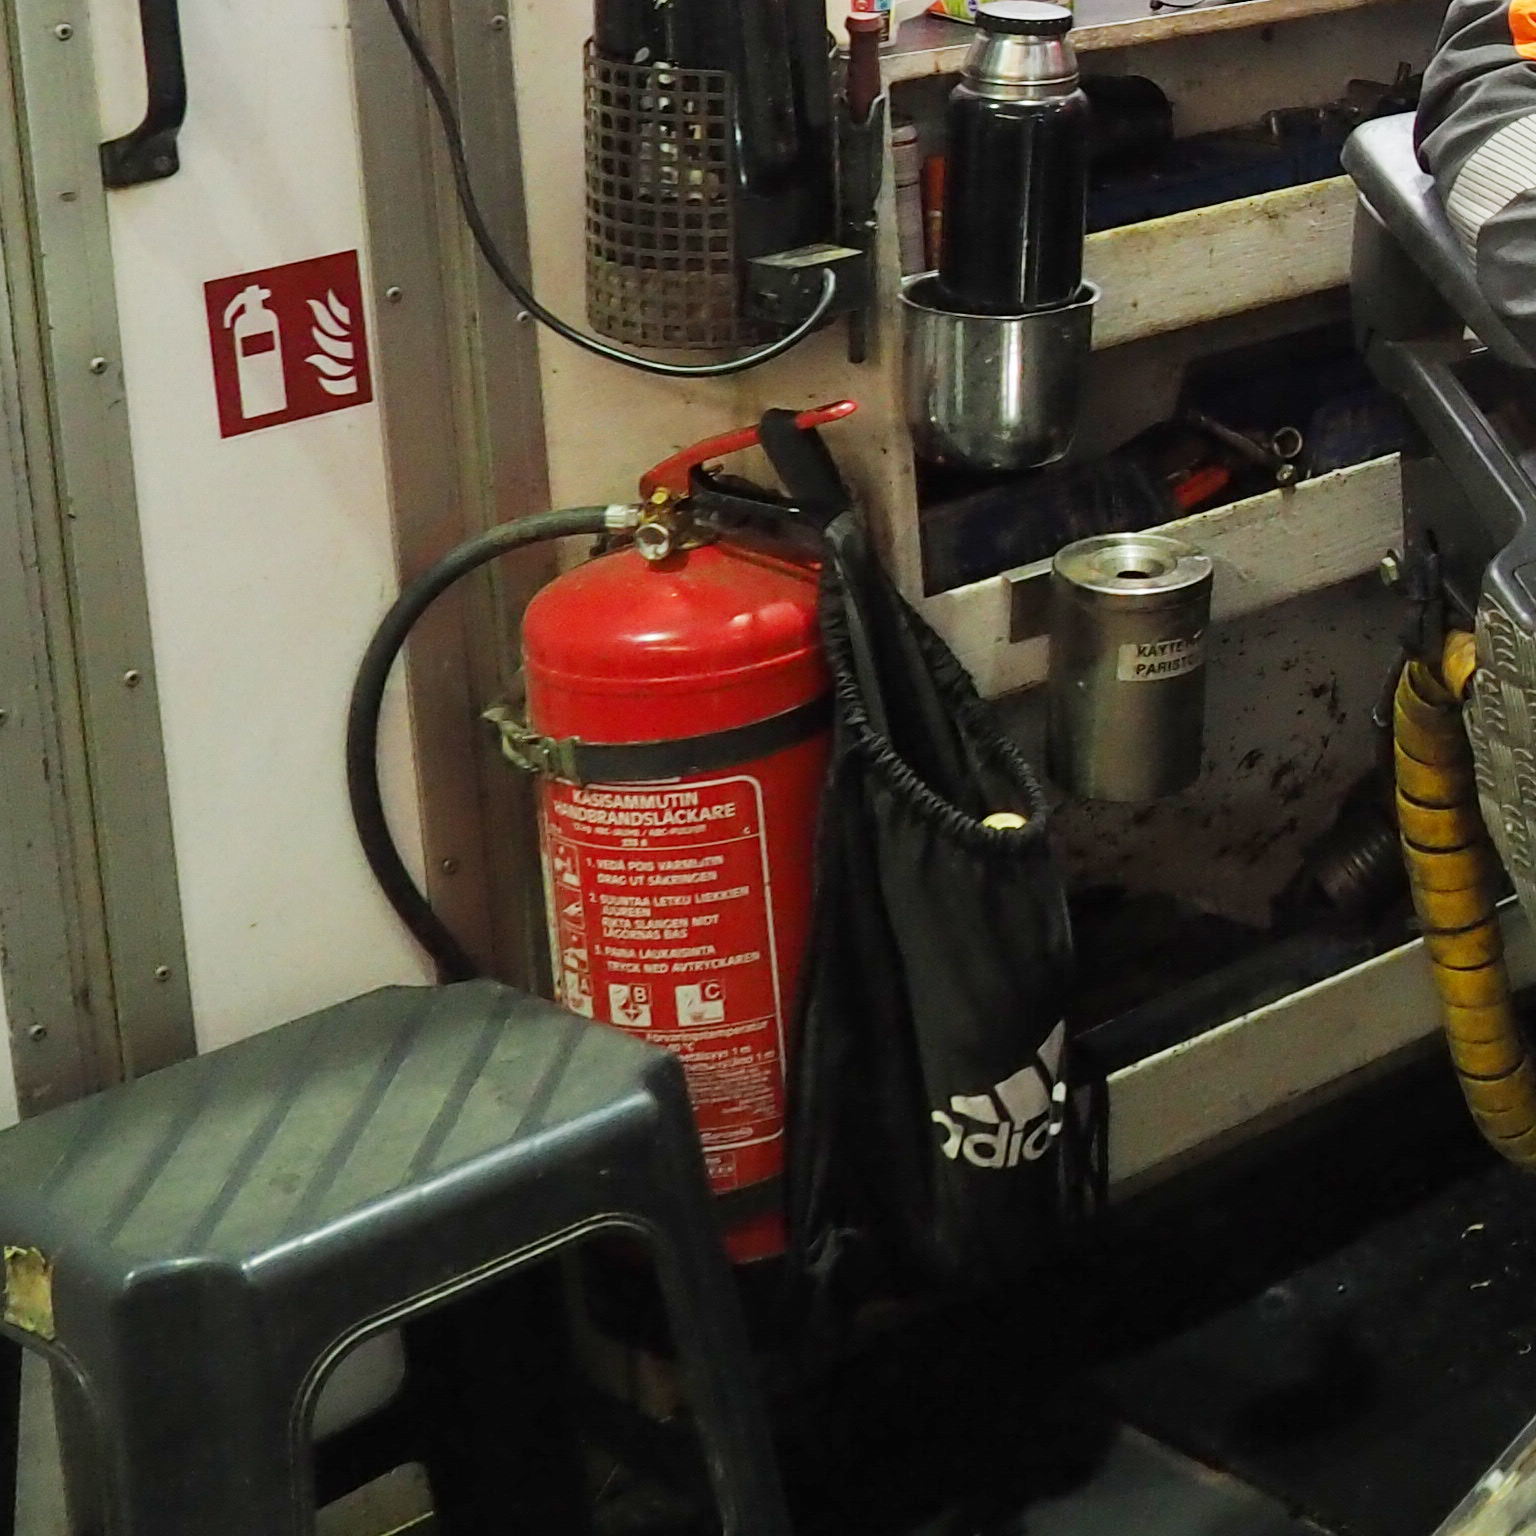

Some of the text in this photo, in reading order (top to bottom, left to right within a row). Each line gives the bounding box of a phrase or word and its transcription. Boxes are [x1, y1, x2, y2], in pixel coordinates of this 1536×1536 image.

[553, 800, 737, 827] HANDBRANDSLÄCKARE
[634, 986, 648, 1001] B
[705, 982, 722, 1000] C
